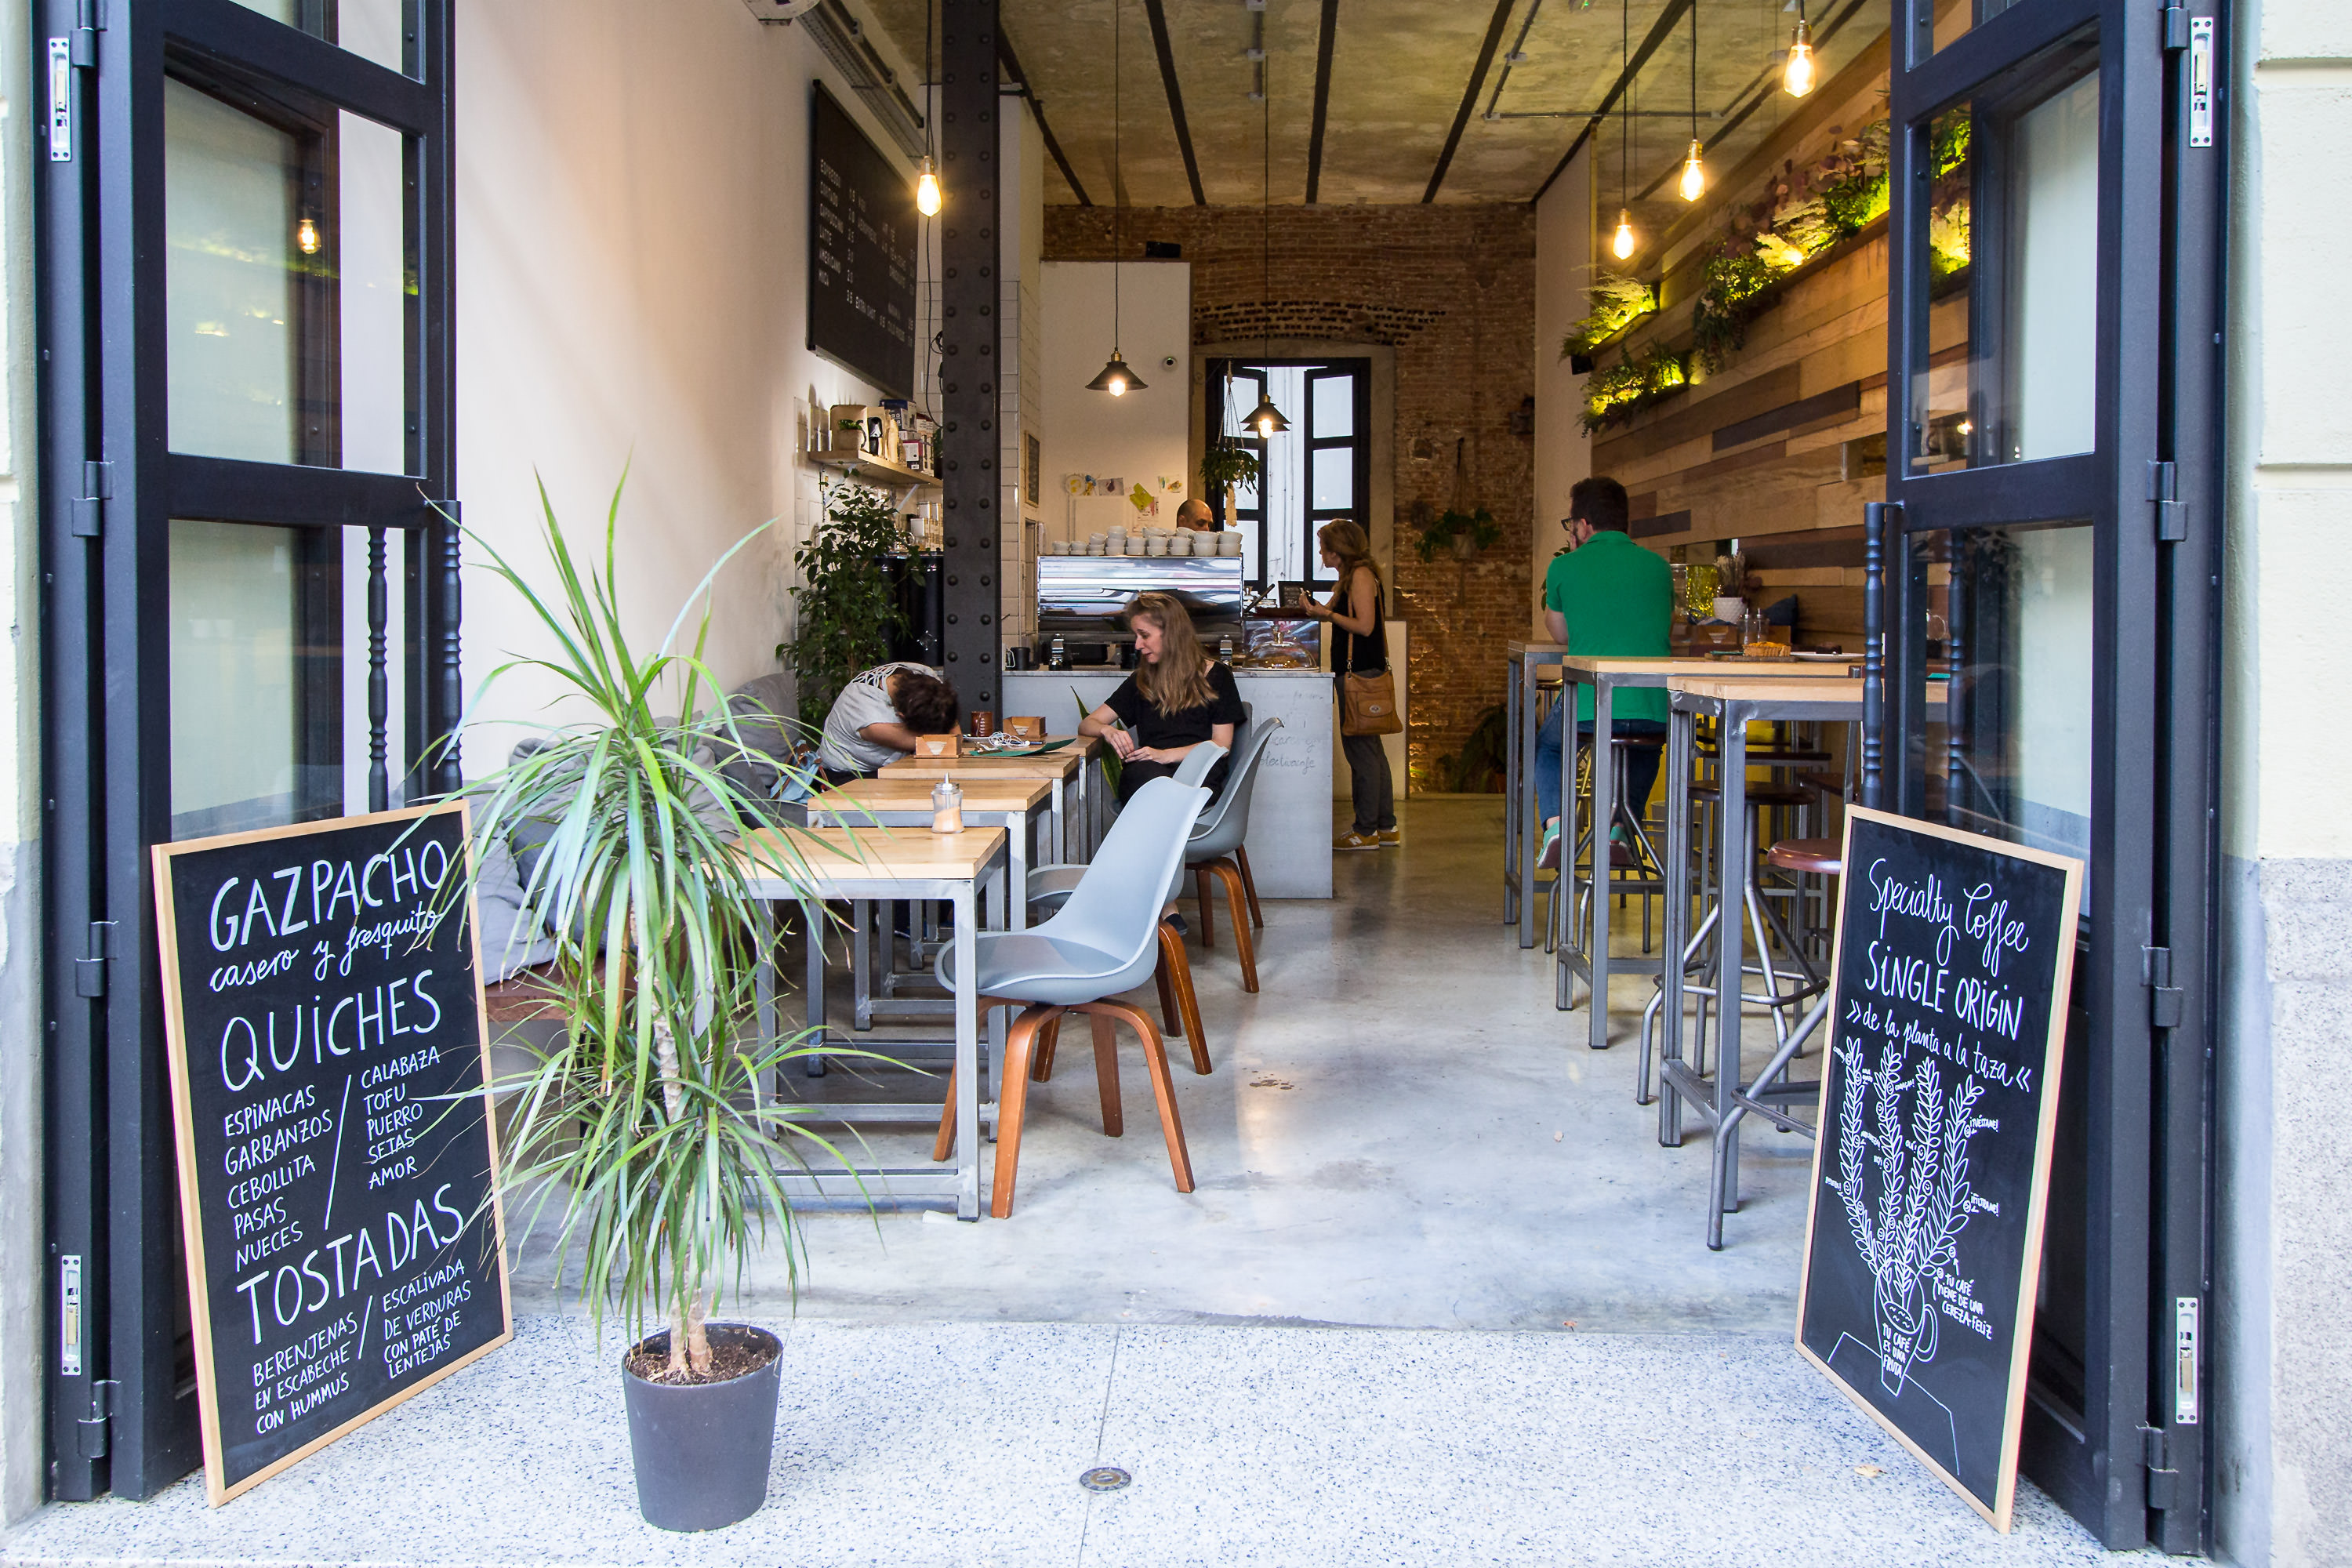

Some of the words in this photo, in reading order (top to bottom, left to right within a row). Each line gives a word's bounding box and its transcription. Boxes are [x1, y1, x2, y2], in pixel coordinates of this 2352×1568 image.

[209, 840, 448, 951] GAZPACHO
[1869, 858, 1960, 967] Specialty
[1963, 883, 2029, 978] Coffee
[209, 949, 299, 993] casero
[313, 941, 336, 981] y
[339, 900, 441, 977] fresquito
[1884, 1009, 1900, 1038] la
[1903, 1019, 1940, 1059] planta
[1944, 1042, 1952, 1060] a
[1956, 1033, 1968, 1068] la
[361, 1046, 441, 1089] CALABAZA
[364, 1083, 406, 1115] TOFU
[367, 1103, 423, 1141] PUERRO
[225, 1109, 332, 1175] GARBANZOS
[368, 1128, 415, 1164] SETAS
[368, 1156, 418, 1189] AMOR
[234, 1196, 287, 1240] PASAS
[236, 1221, 303, 1272] NUECES
[237, 1183, 464, 1344] TOSTADAS
[1945, 1273, 1955, 1287] TU
[1956, 1279, 1975, 1297] CAFÉ
[1958, 1294, 1969, 1308] DE
[384, 1317, 401, 1341] DE
[407, 1280, 471, 1329] VERDURAS
[253, 1312, 358, 1387] BERENJENAS
[384, 1339, 408, 1363] CON
[412, 1316, 441, 1352] PATÉ
[445, 1311, 462, 1333] DE
[387, 1334, 452, 1380] LENTEJAS
[1882, 1323, 1892, 1341] TU
[1893, 1333, 1912, 1352] CAFÉ
[1882, 1340, 1891, 1352] ES
[256, 1385, 271, 1410] EN
[277, 1341, 351, 1400] ESCABECHE
[1882, 1354, 1904, 1379] FRUTA
[256, 1410, 285, 1436] CON
[290, 1372, 350, 1421] HUMMUS
